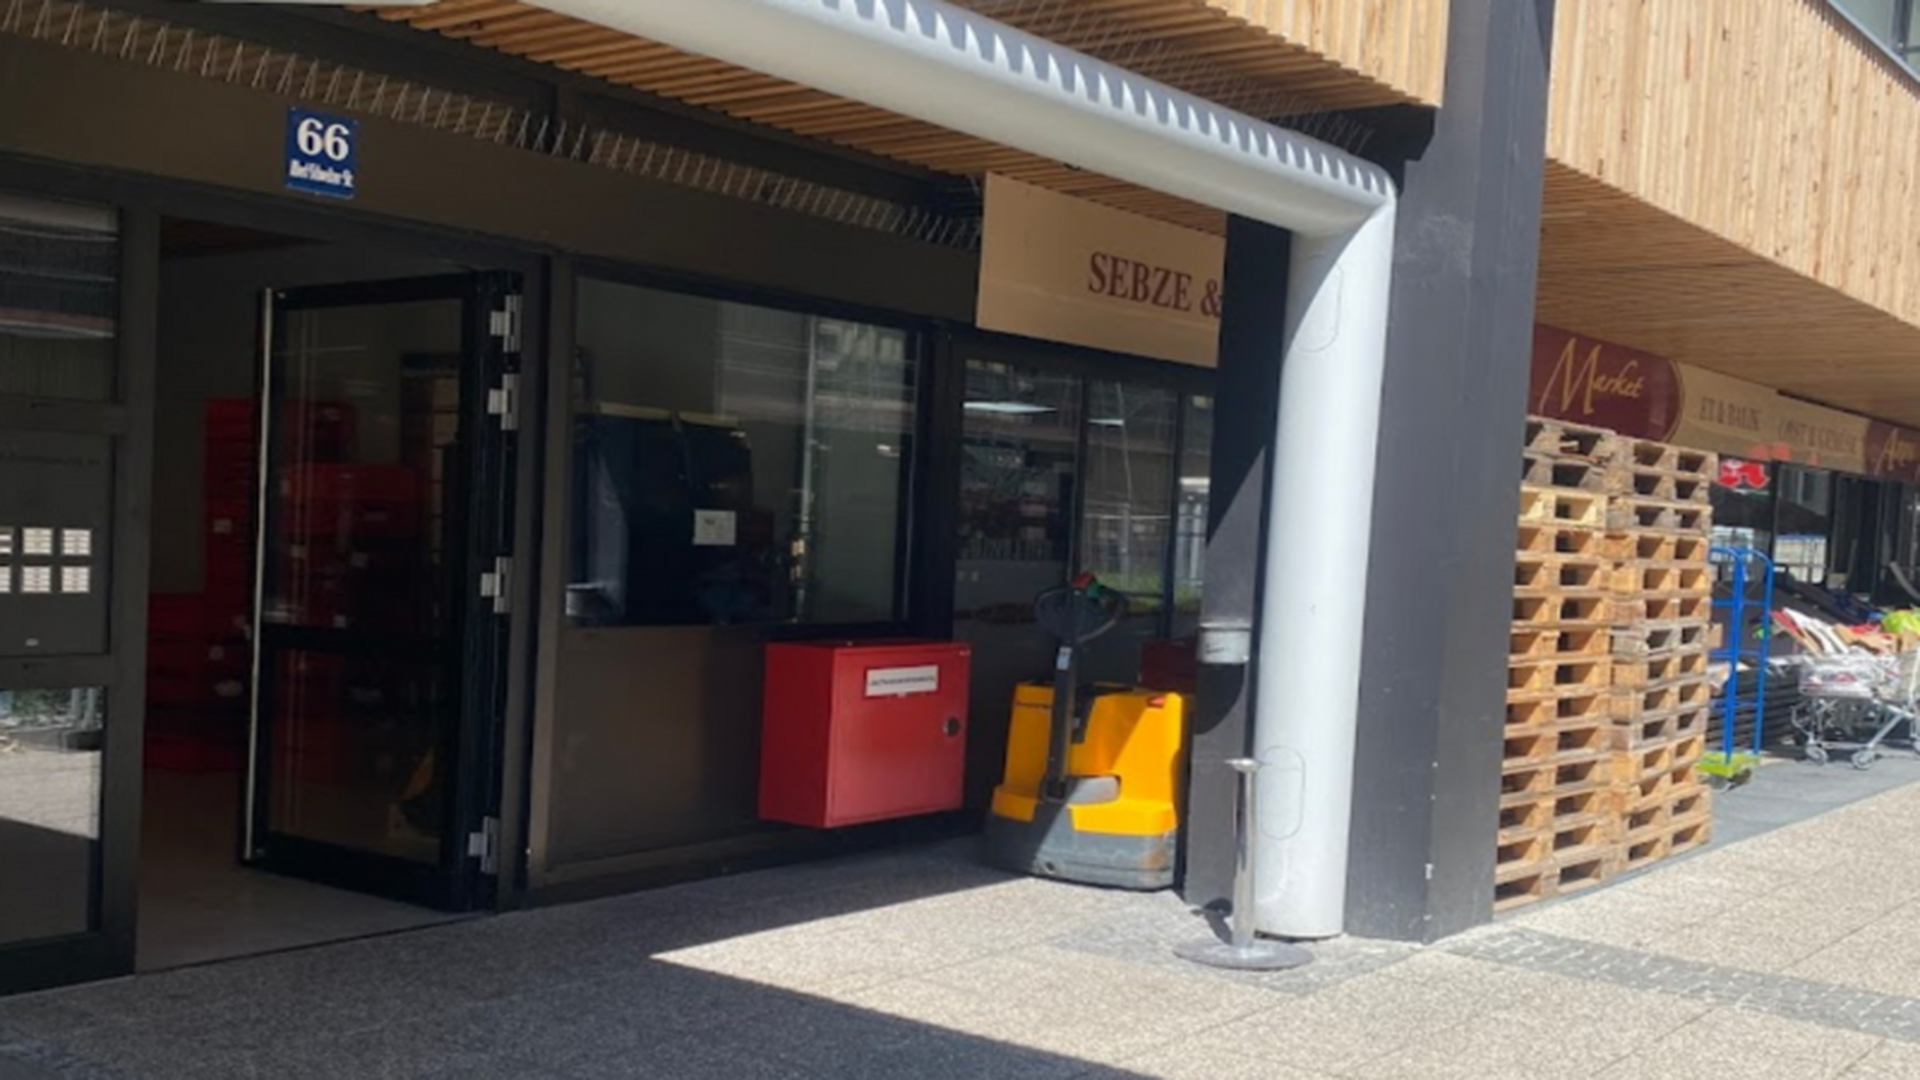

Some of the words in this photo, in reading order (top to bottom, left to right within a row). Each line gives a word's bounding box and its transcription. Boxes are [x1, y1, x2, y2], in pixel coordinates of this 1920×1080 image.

[297, 118, 350, 161] 66
[1088, 251, 1192, 312] SEBZE
[1201, 279, 1221, 318] &
[1539, 337, 1644, 416] Market
